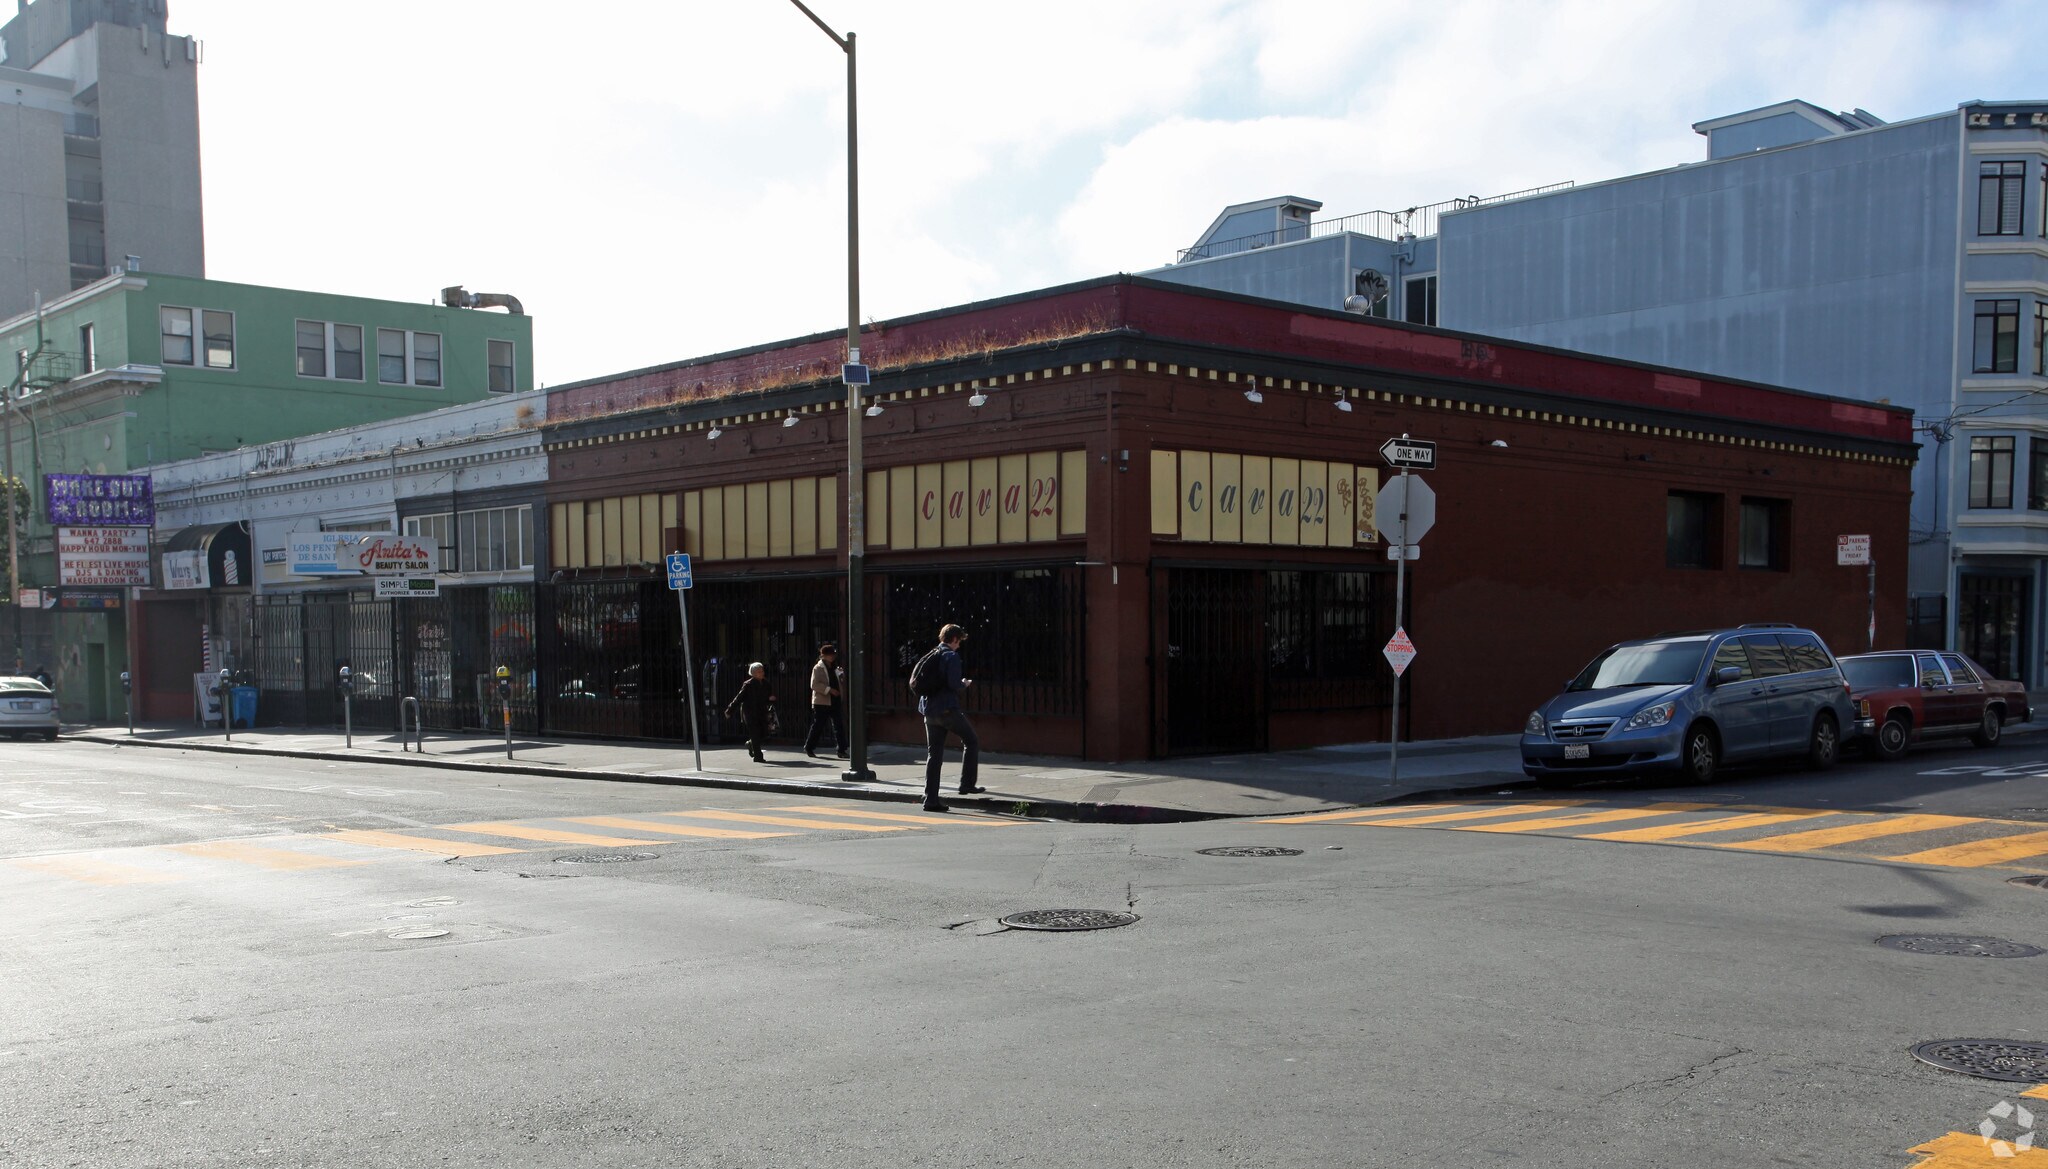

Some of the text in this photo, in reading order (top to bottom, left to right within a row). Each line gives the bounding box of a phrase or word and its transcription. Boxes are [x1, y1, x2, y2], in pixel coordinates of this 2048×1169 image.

[1396, 448, 1430, 460] ONE WAY
[53, 479, 144, 497] MAKE OUT
[77, 501, 129, 518] ROOM
[70, 529, 99, 537] WANNA
[84, 537, 123, 545] 647 2888
[61, 545, 87, 553] HAPPY
[89, 545, 111, 553] HOUR
[293, 544, 311, 552] LOS
[299, 553, 310, 561] DE
[312, 553, 331, 561] SAN
[360, 539, 429, 567] Anita's
[125, 560, 150, 568] MUSIC
[375, 561, 429, 570] BEAUTY SALON
[76, 569, 92, 577] DJS
[669, 571, 690, 579] PARKING
[380, 580, 435, 589] SIMPLE Mobile
[674, 579, 687, 587] ONLY
[1396, 631, 1406, 640] NO
[1386, 643, 1413, 653] STOPPING
